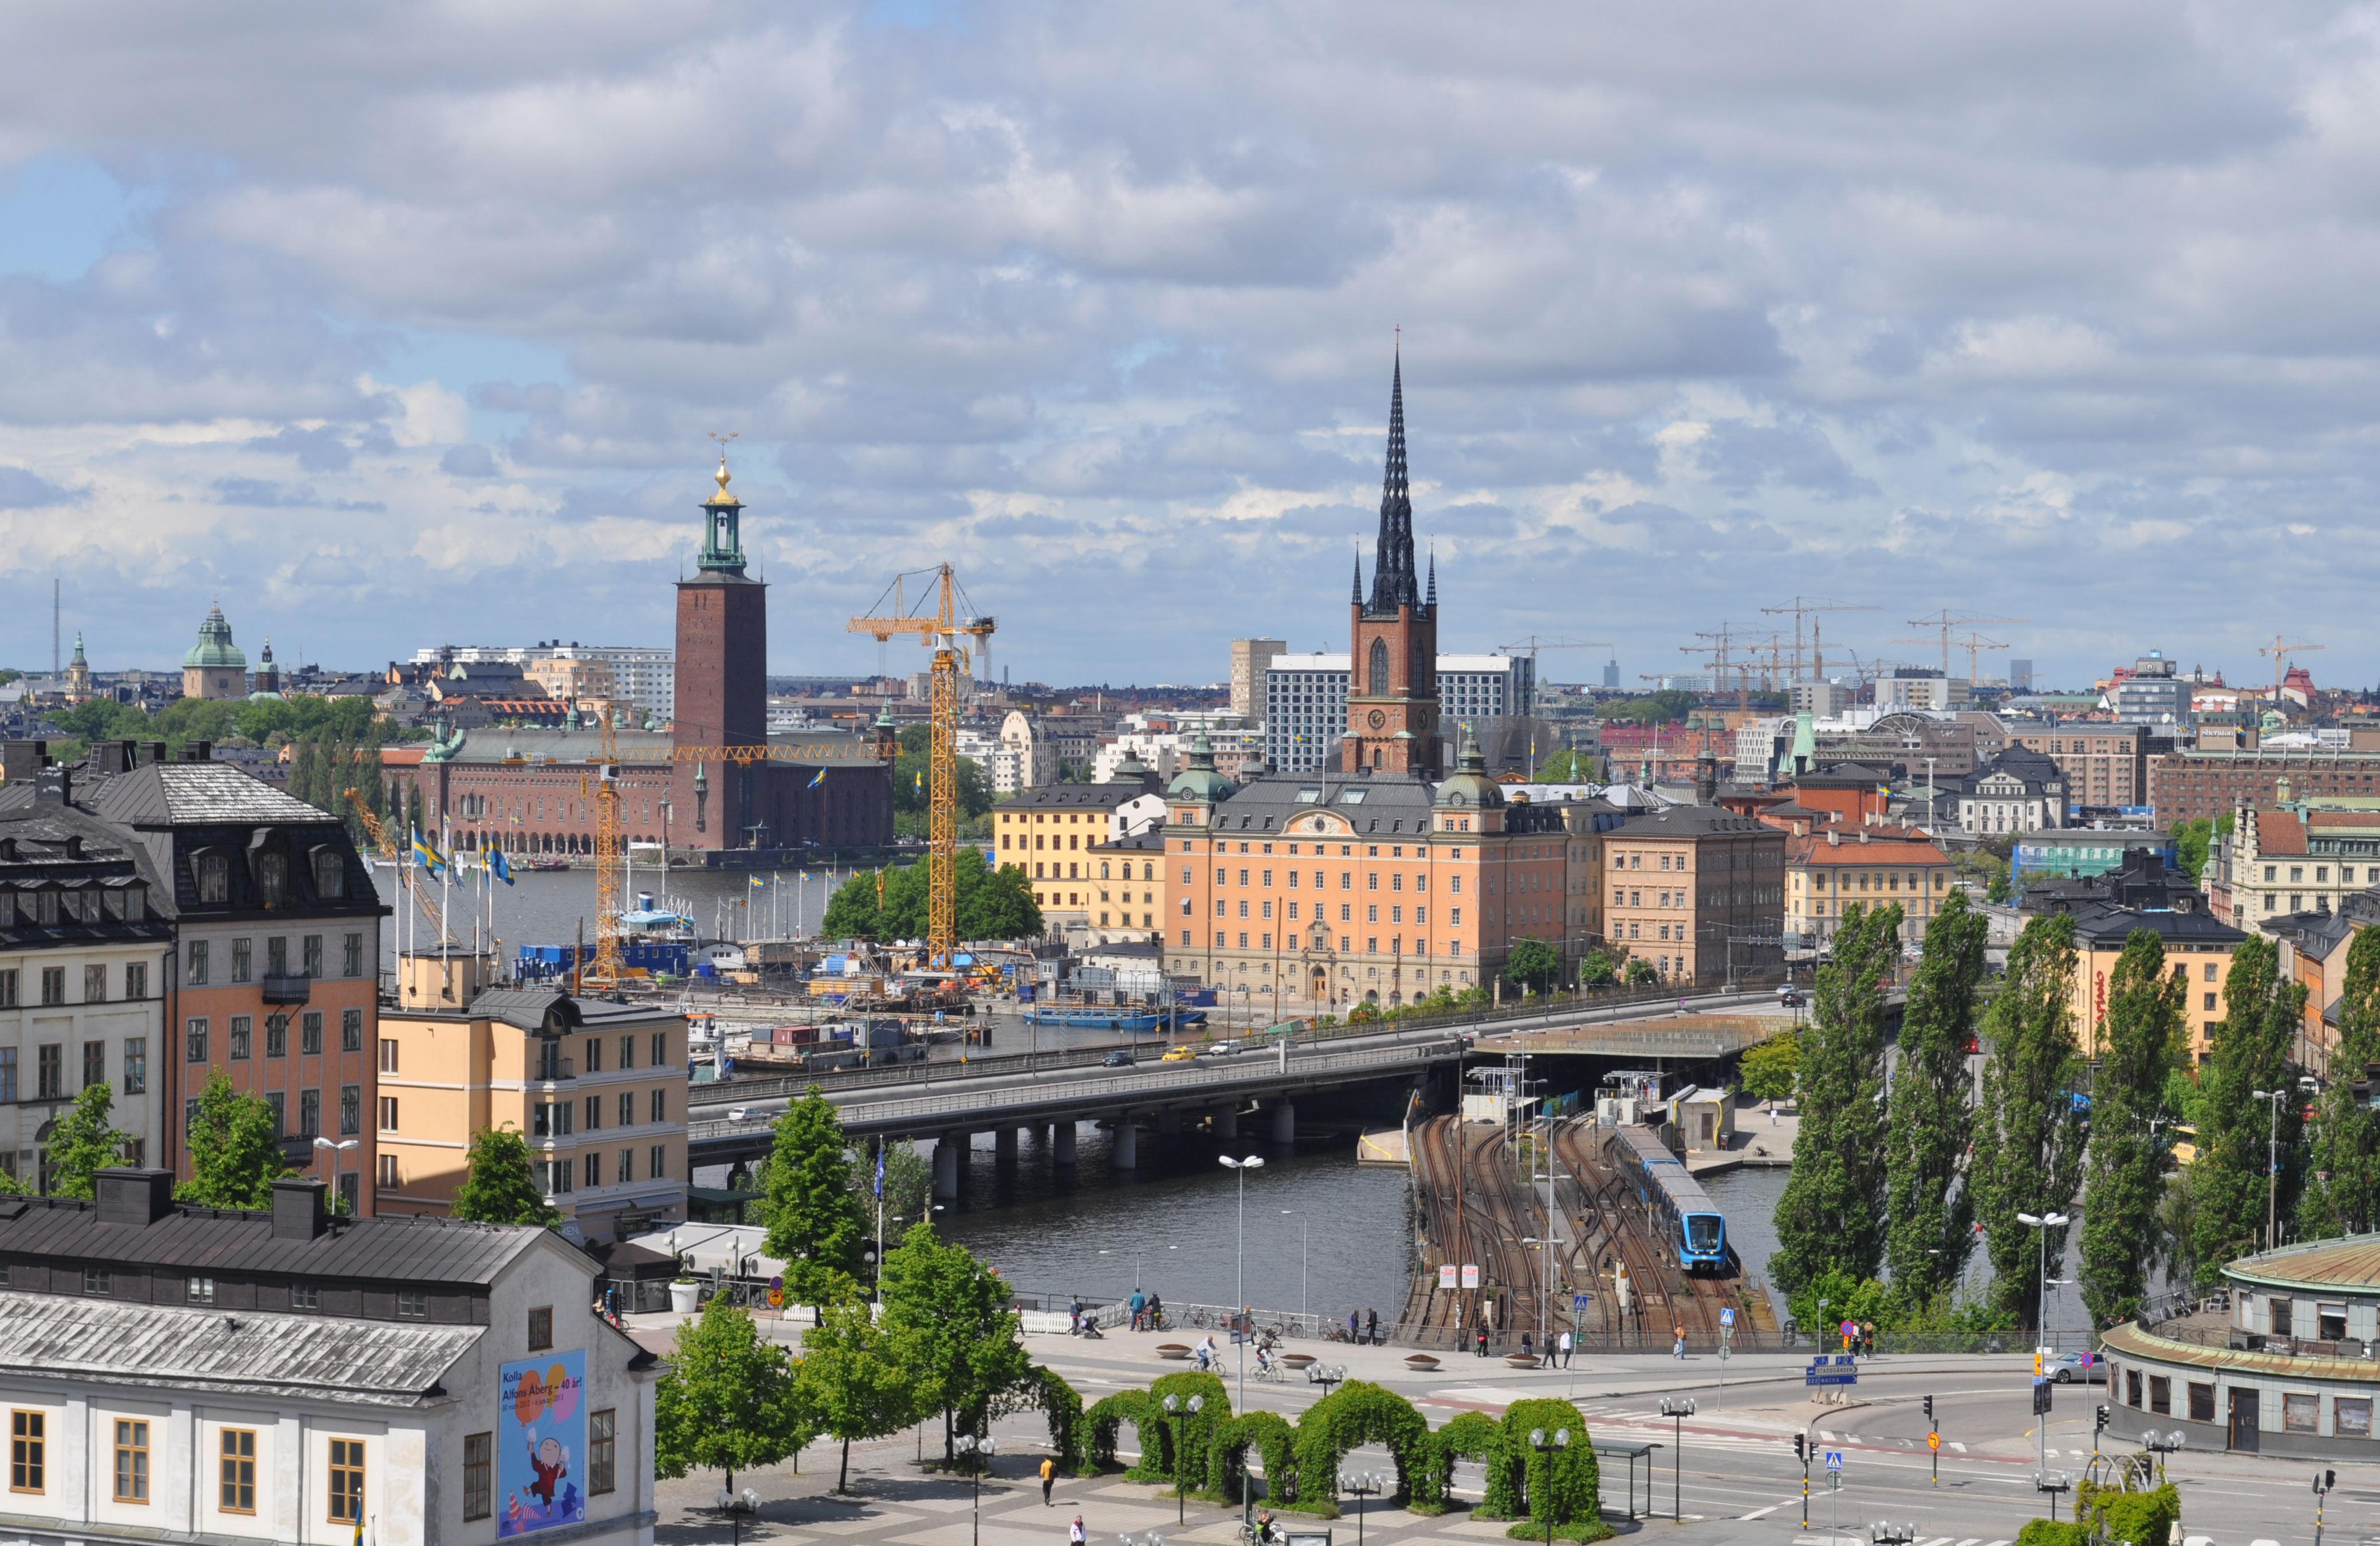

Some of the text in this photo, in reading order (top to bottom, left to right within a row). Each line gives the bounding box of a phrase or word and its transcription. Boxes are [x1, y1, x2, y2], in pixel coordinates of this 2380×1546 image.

[512, 957, 561, 979] Hilton
[503, 1370, 522, 1384] Kolla
[502, 1388, 527, 1401] Alfons
[529, 1383, 553, 1396] Åberg
[560, 1378, 570, 1390] 40
[572, 1376, 582, 1388] år!
[502, 1403, 508, 1412] 30
[520, 1399, 530, 1409] 2012
[538, 1398, 553, 1406] januari
[553, 1394, 564, 1402] 2013
